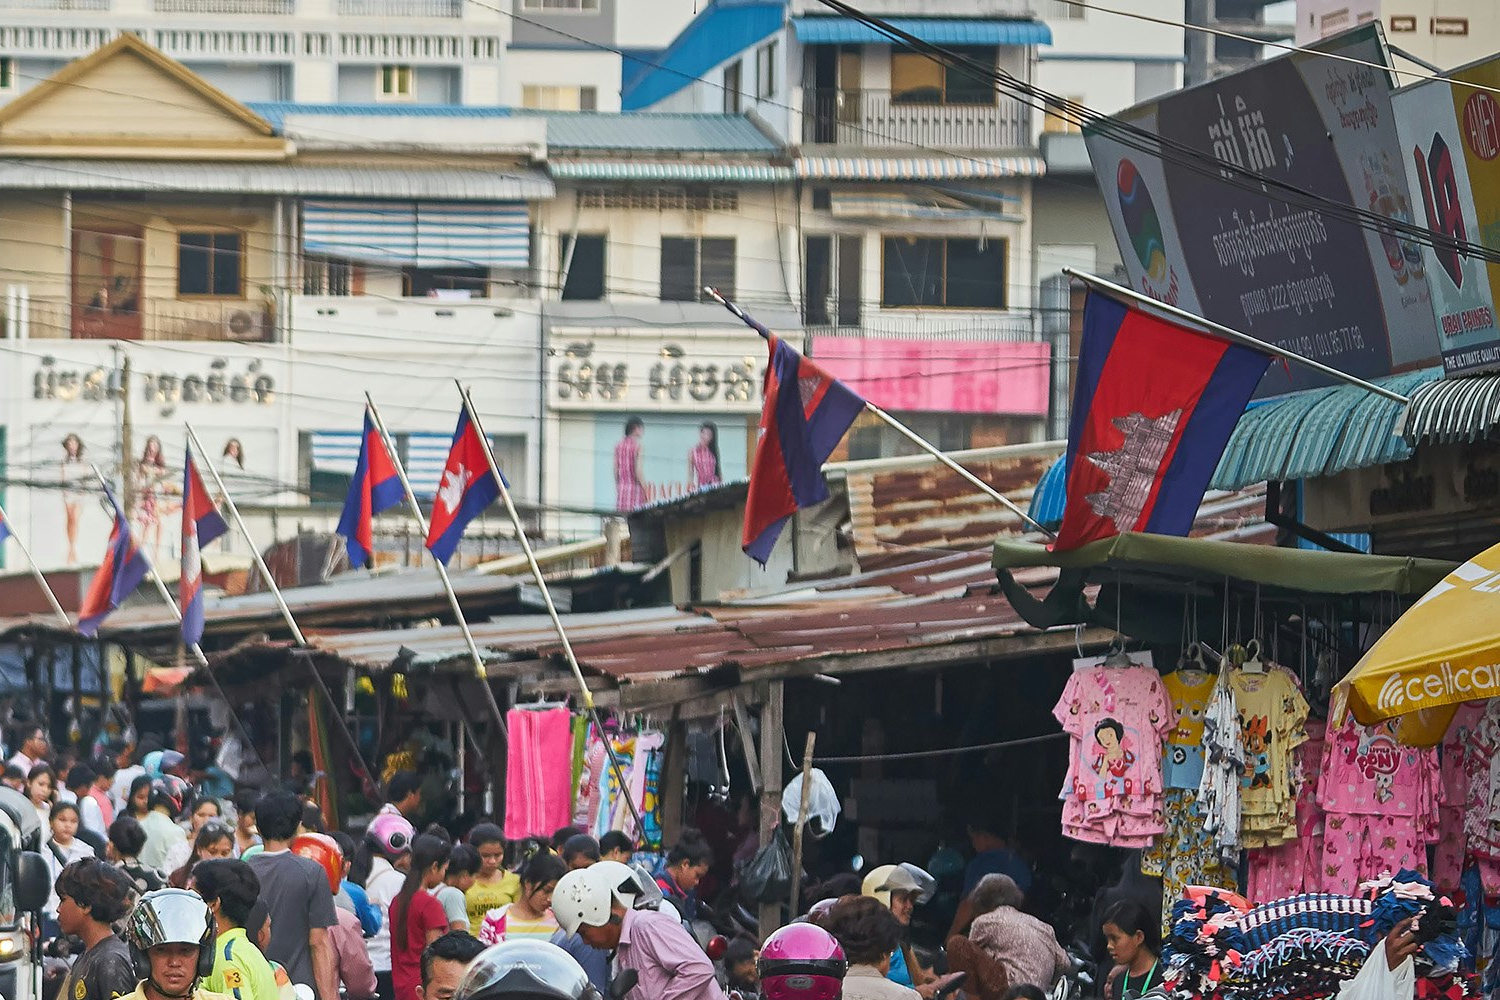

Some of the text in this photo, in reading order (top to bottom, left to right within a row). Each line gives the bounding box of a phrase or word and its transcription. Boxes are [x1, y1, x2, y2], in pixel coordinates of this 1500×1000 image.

[1461, 306, 1493, 331] PAINTS
[1445, 355, 1457, 369] THE
[1356, 749, 1401, 780] PONY
[232, 972, 241, 983] 3
